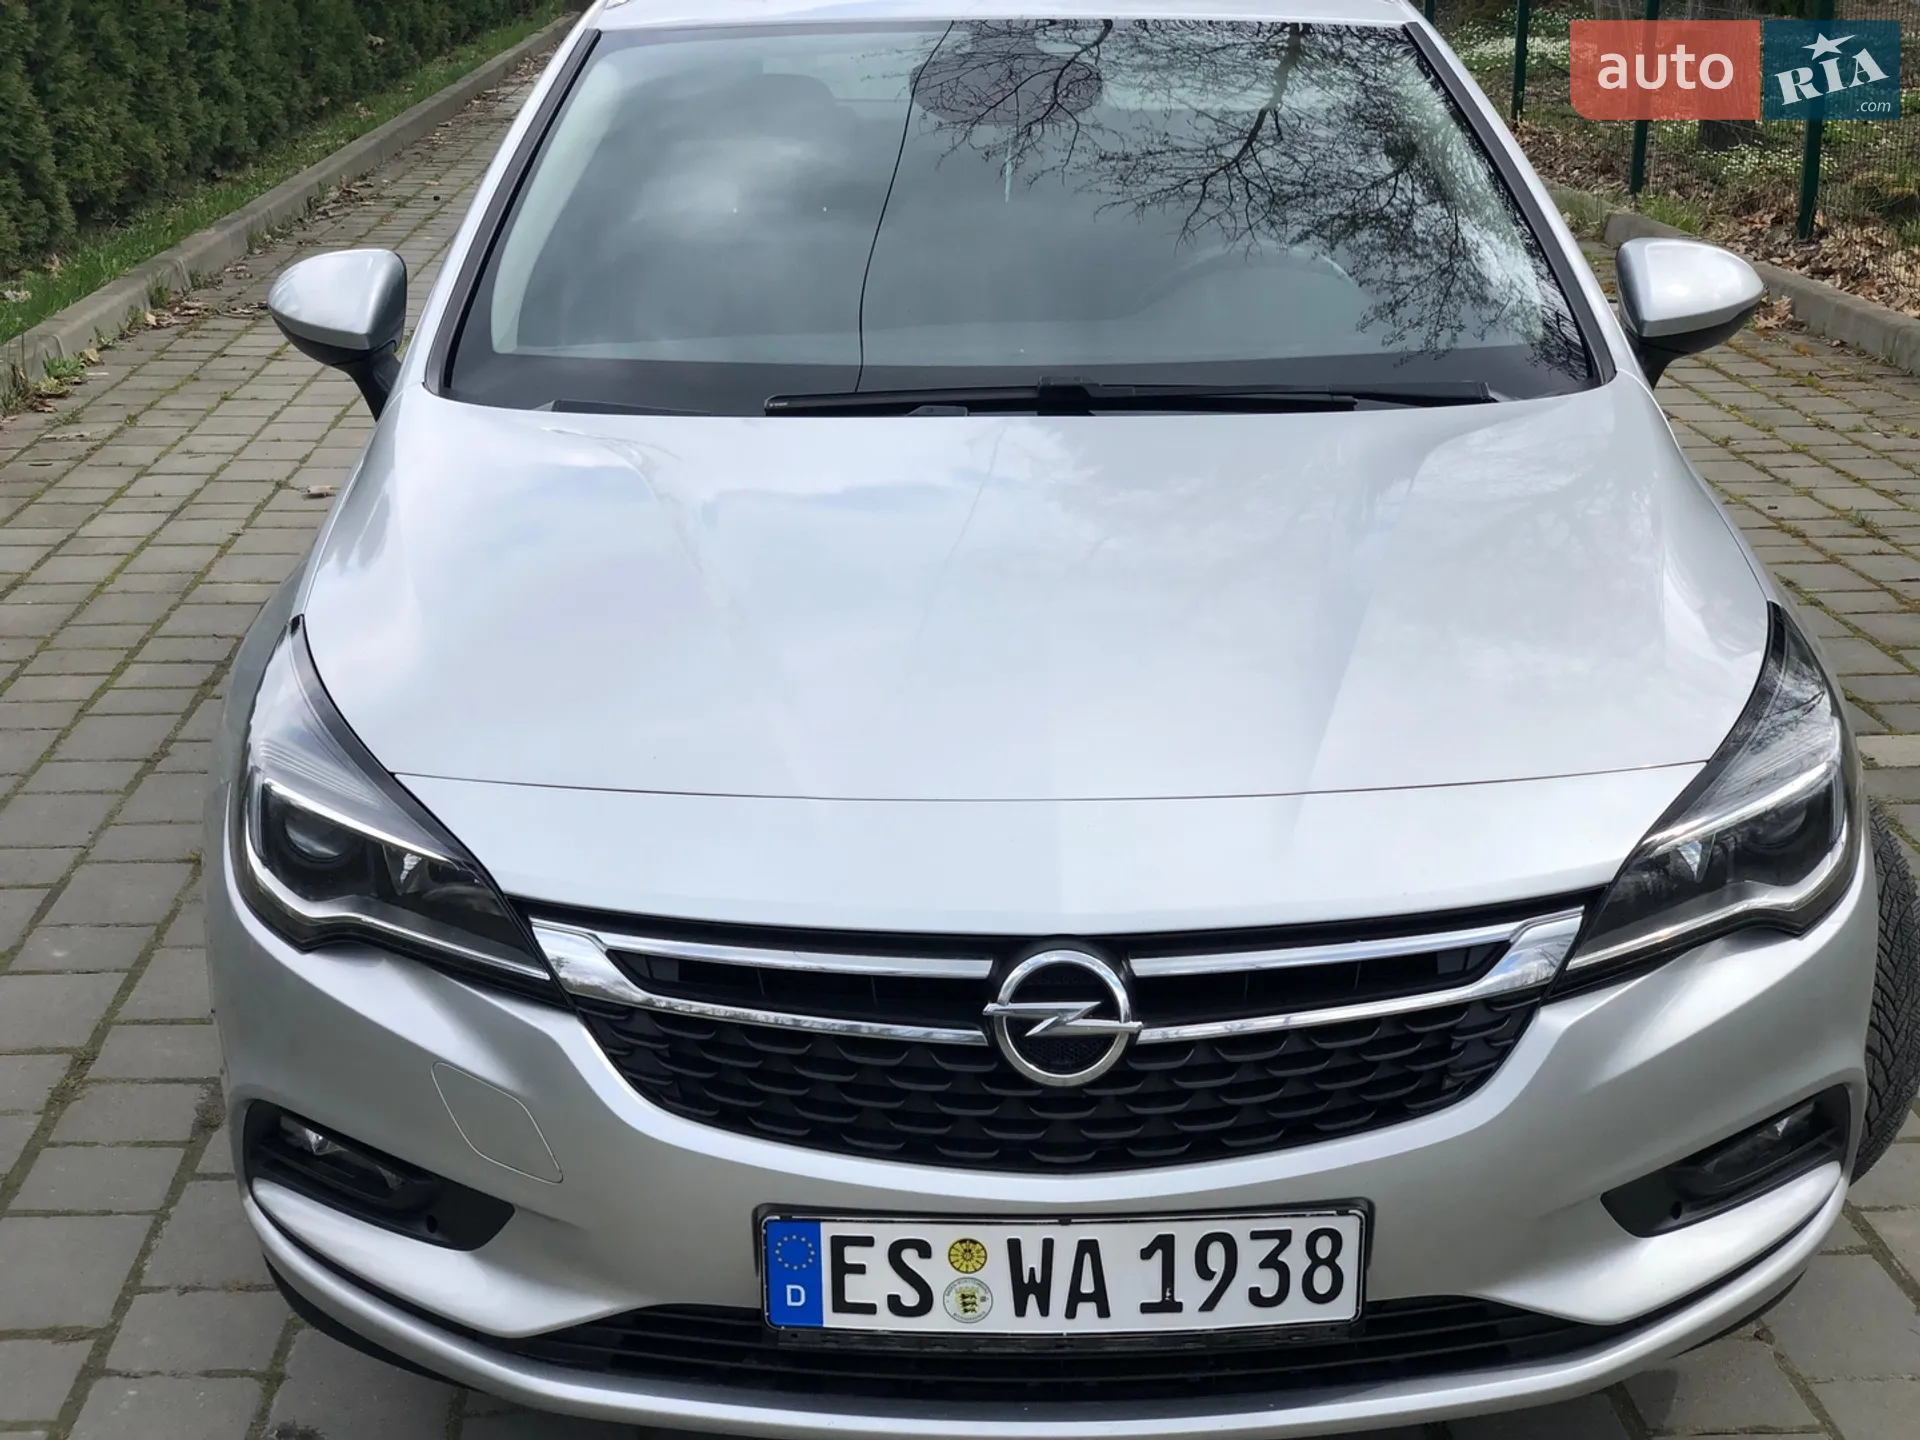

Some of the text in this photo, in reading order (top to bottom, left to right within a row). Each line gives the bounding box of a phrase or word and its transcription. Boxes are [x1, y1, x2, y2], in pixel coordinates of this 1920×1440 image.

[786, 1284, 806, 1307] D
[830, 1227, 1345, 1319] ES WA 1938
